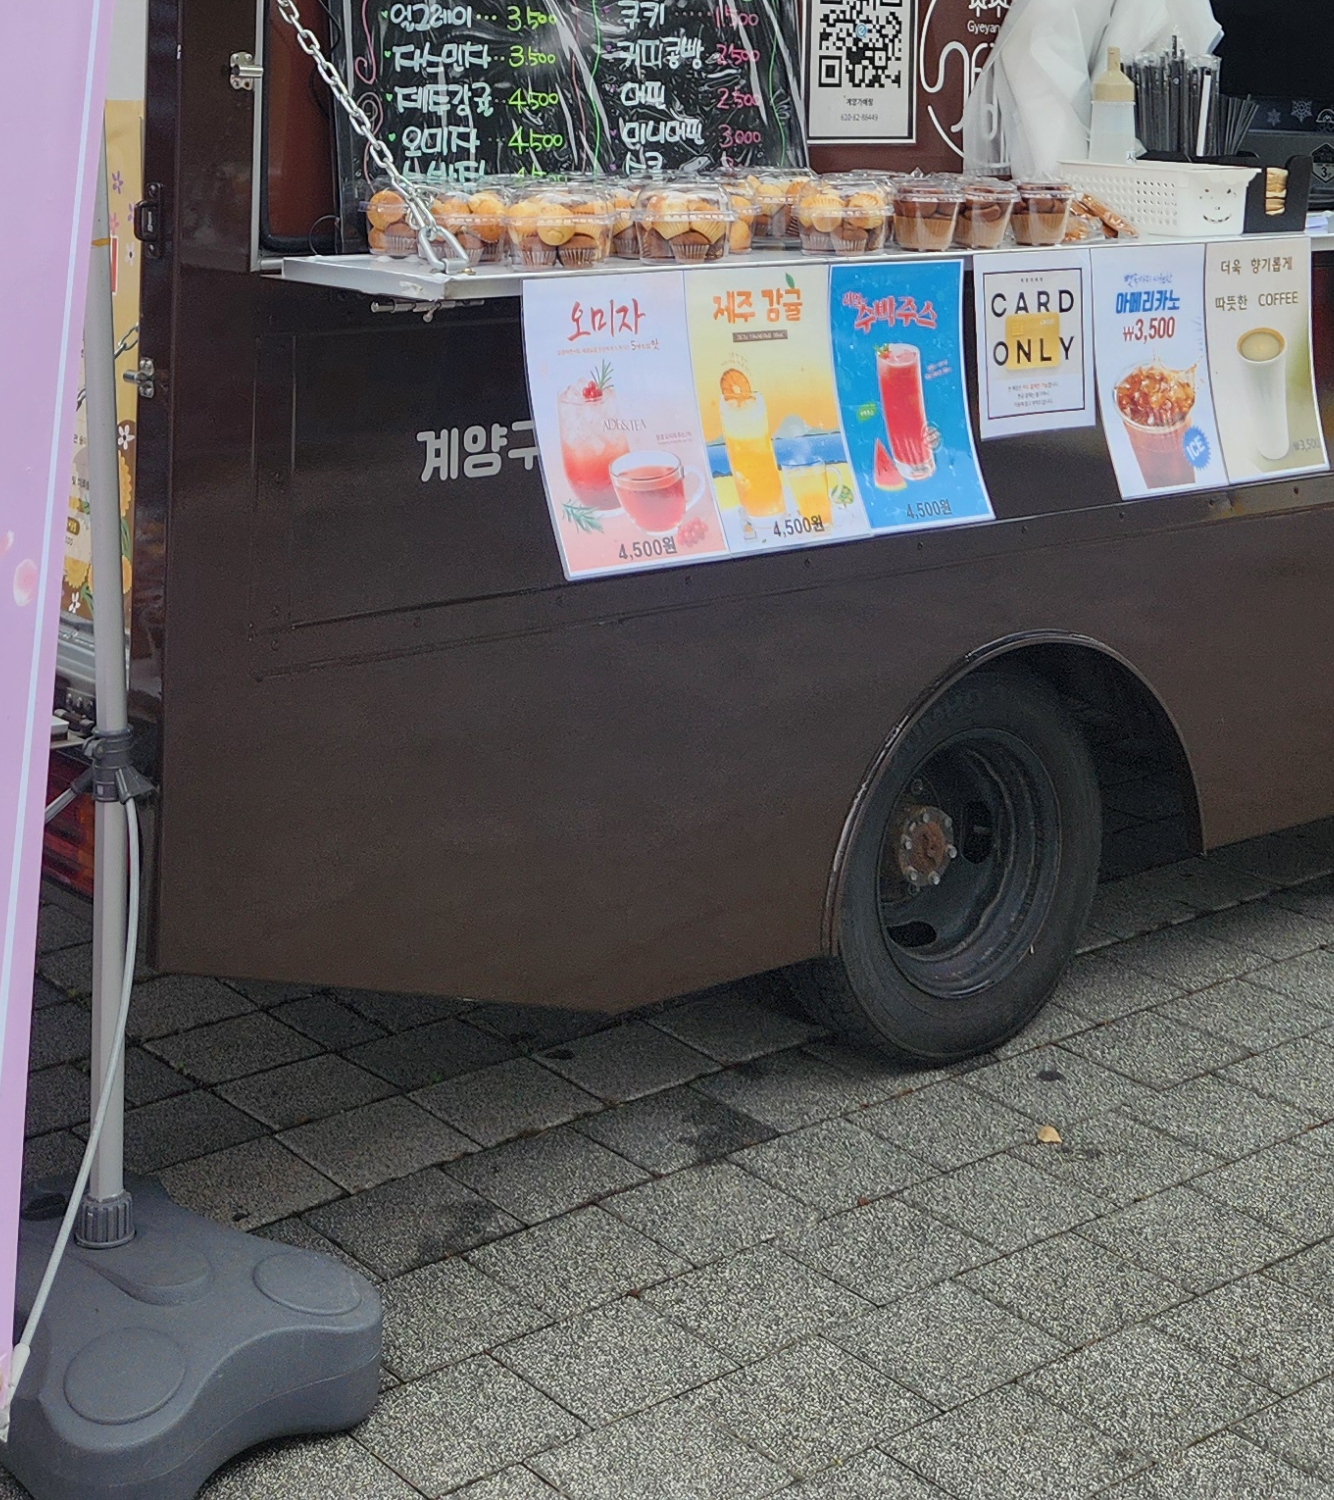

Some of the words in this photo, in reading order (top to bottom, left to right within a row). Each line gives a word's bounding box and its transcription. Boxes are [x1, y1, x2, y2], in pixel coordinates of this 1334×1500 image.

[390, 3, 472, 33] 얼그레이
[617, 0, 665, 30] 쿠키
[967, 20, 1001, 35] Gyeyan
[402, 125, 481, 157] 오미자
[622, 118, 705, 145] 미니머핀
[1220, 259, 1242, 275] 더욱
[1251, 256, 1293, 274] 향기롭게
[712, 290, 756, 325] 제주
[761, 287, 803, 323] 감귤
[854, 295, 938, 334] 수박주스
[990, 288, 1075, 318] CARD
[1115, 289, 1181, 315] 아메리카노
[1215, 295, 1249, 312] 따뜻한
[1257, 290, 1299, 308] COFFEE
[567, 297, 647, 342] 오미자
[993, 334, 1075, 367] ONLY
[416, 420, 539, 483] 계양구
[1185, 434, 1207, 462] ICE
[905, 498, 953, 520] 4,500원
[773, 514, 826, 538] 4,500원
[618, 535, 678, 561] 4,500원
